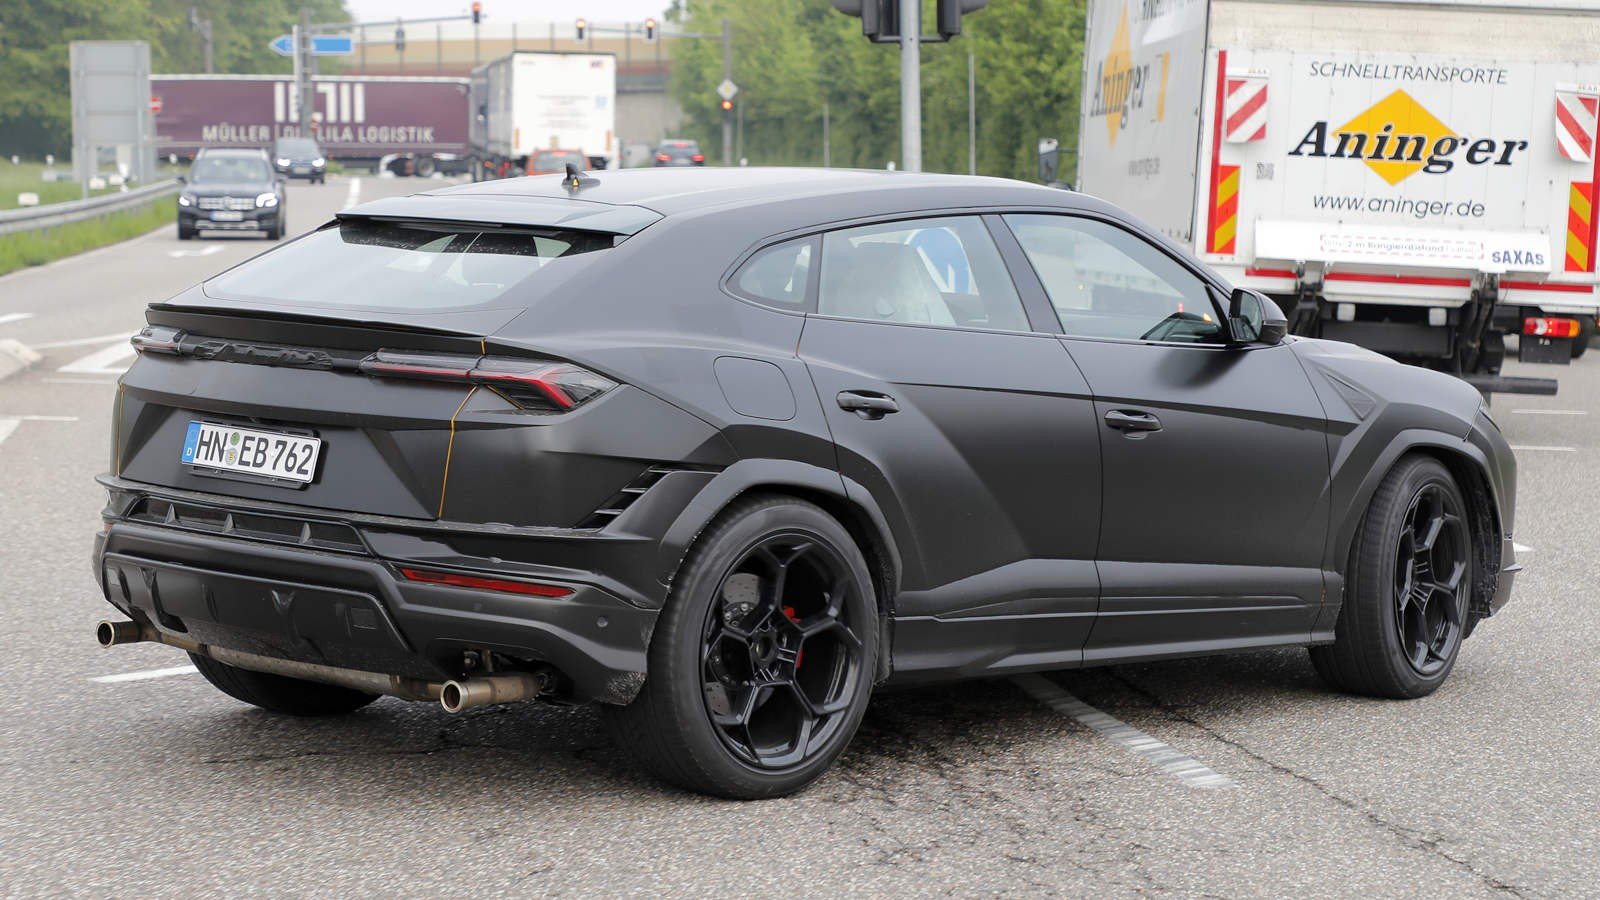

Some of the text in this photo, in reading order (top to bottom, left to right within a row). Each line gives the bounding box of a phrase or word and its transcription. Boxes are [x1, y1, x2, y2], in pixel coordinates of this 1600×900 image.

[1310, 61, 1508, 84] SCHNELLTRANSPORTE
[1090, 56, 1150, 130] Aninger
[202, 122, 270, 142] MÜLLER
[316, 125, 353, 142] LILA
[358, 126, 434, 143] LOGISTIK
[1287, 121, 1528, 174] Aninger
[1313, 195, 1485, 219] www.aninger.de
[186, 429, 314, 475] D HN EB 762
